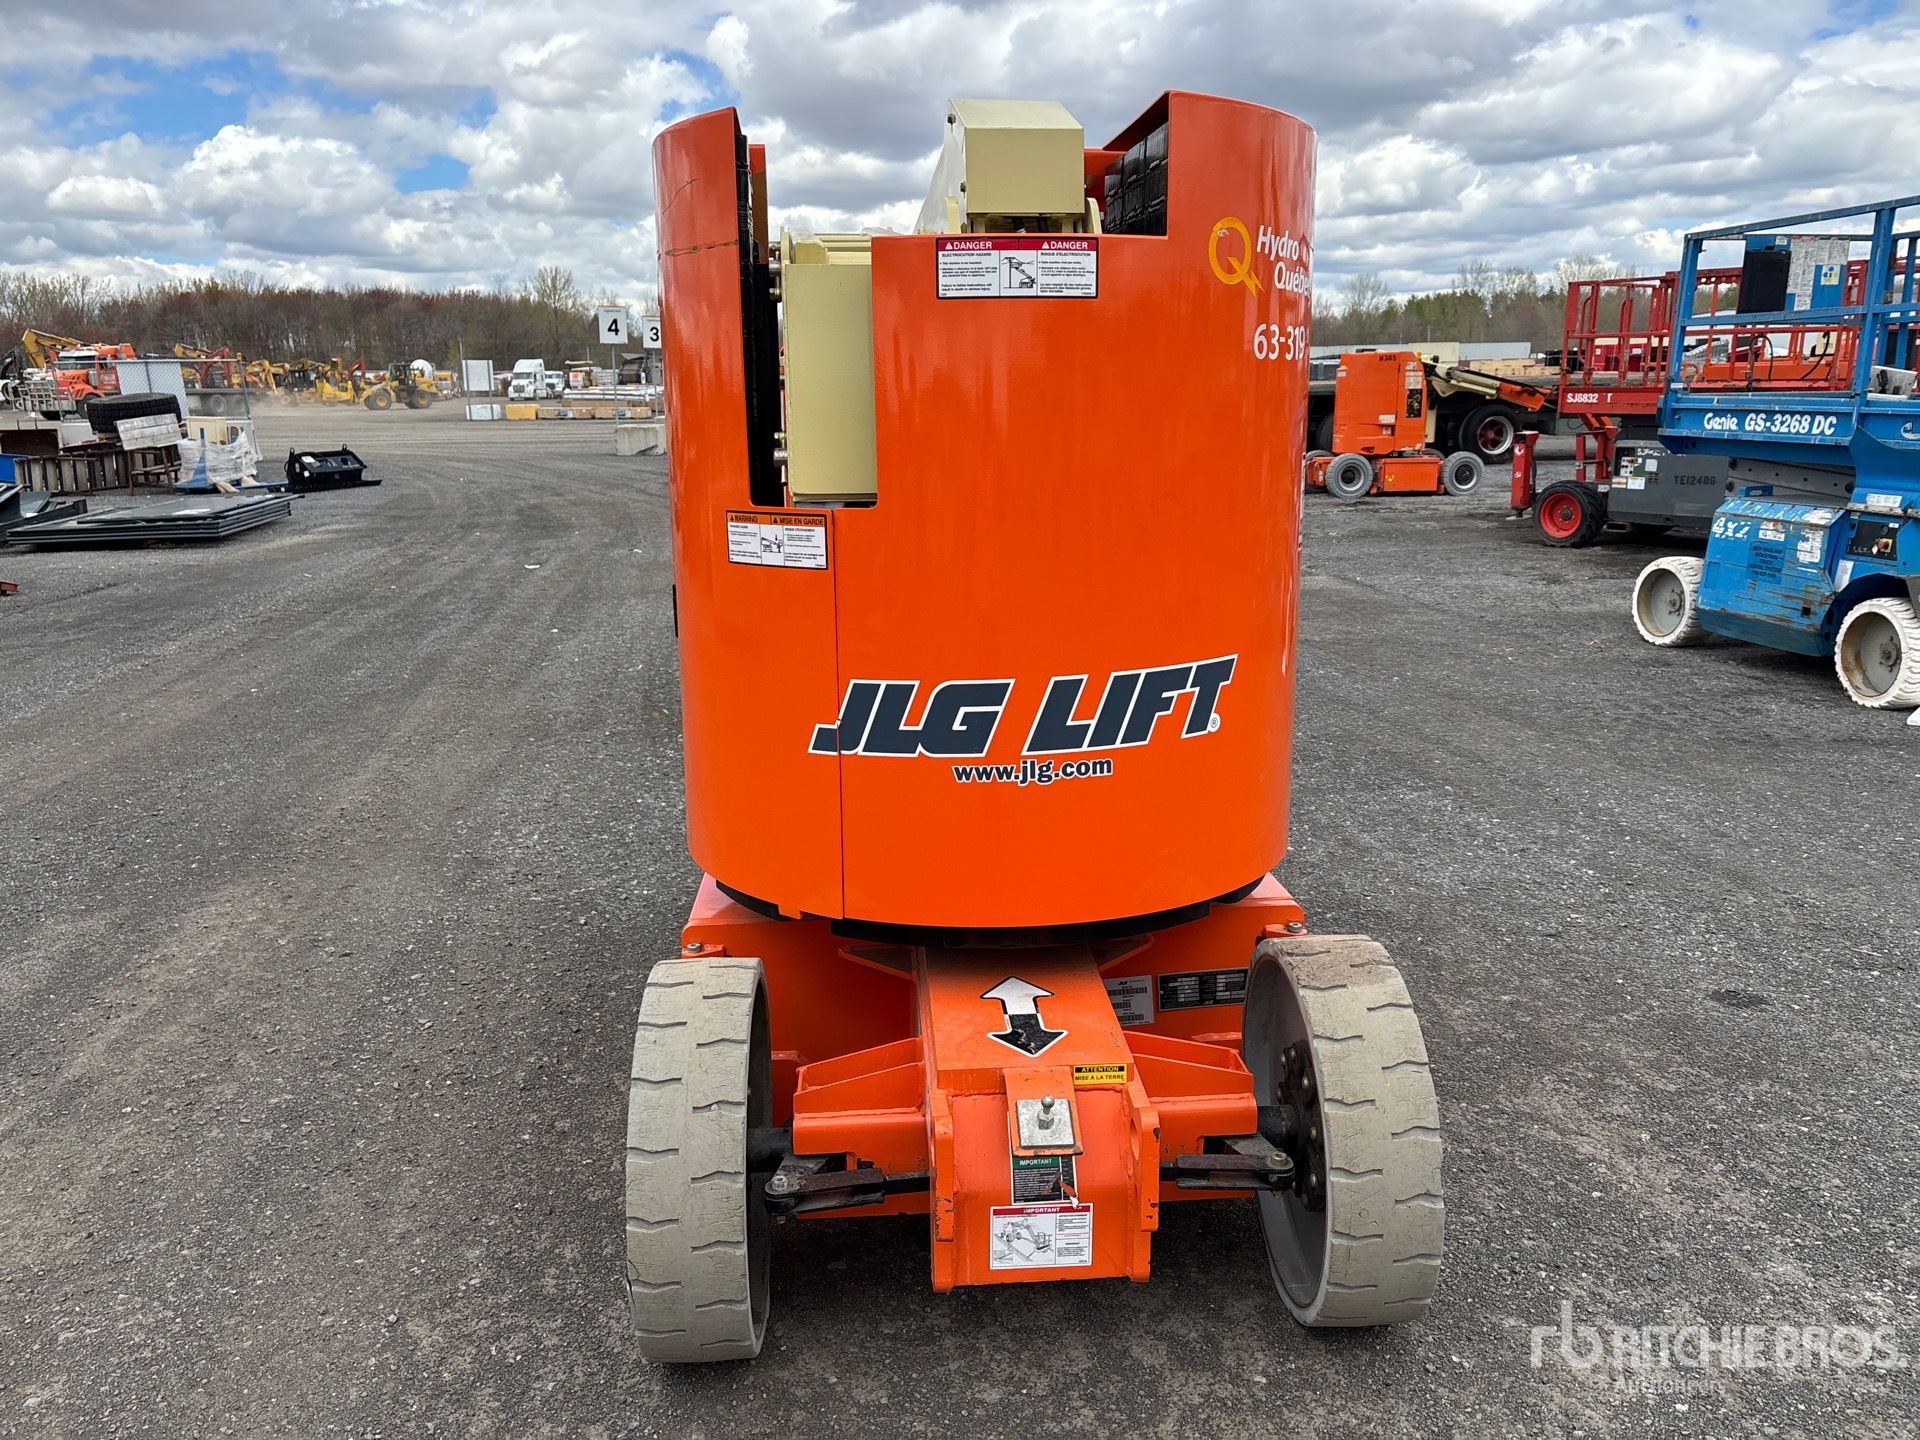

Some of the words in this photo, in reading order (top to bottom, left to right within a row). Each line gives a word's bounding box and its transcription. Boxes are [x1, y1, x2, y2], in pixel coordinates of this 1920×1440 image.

[953, 241, 993, 250] DANGER
[1050, 241, 1088, 250] DANGER
[1256, 225, 1300, 261] Hydro
[608, 318, 619, 335] 4
[650, 327, 659, 342] 3
[1567, 393, 1598, 403] SJ6832
[1704, 413, 1738, 430] Genie
[1745, 413, 1810, 434] GS-3268
[1811, 415, 1837, 435] DC
[734, 515, 758, 523] WARNING
[807, 678, 1016, 758] JLG
[1021, 653, 1239, 756] LIFT
[952, 757, 1113, 786] www.jlg.com
